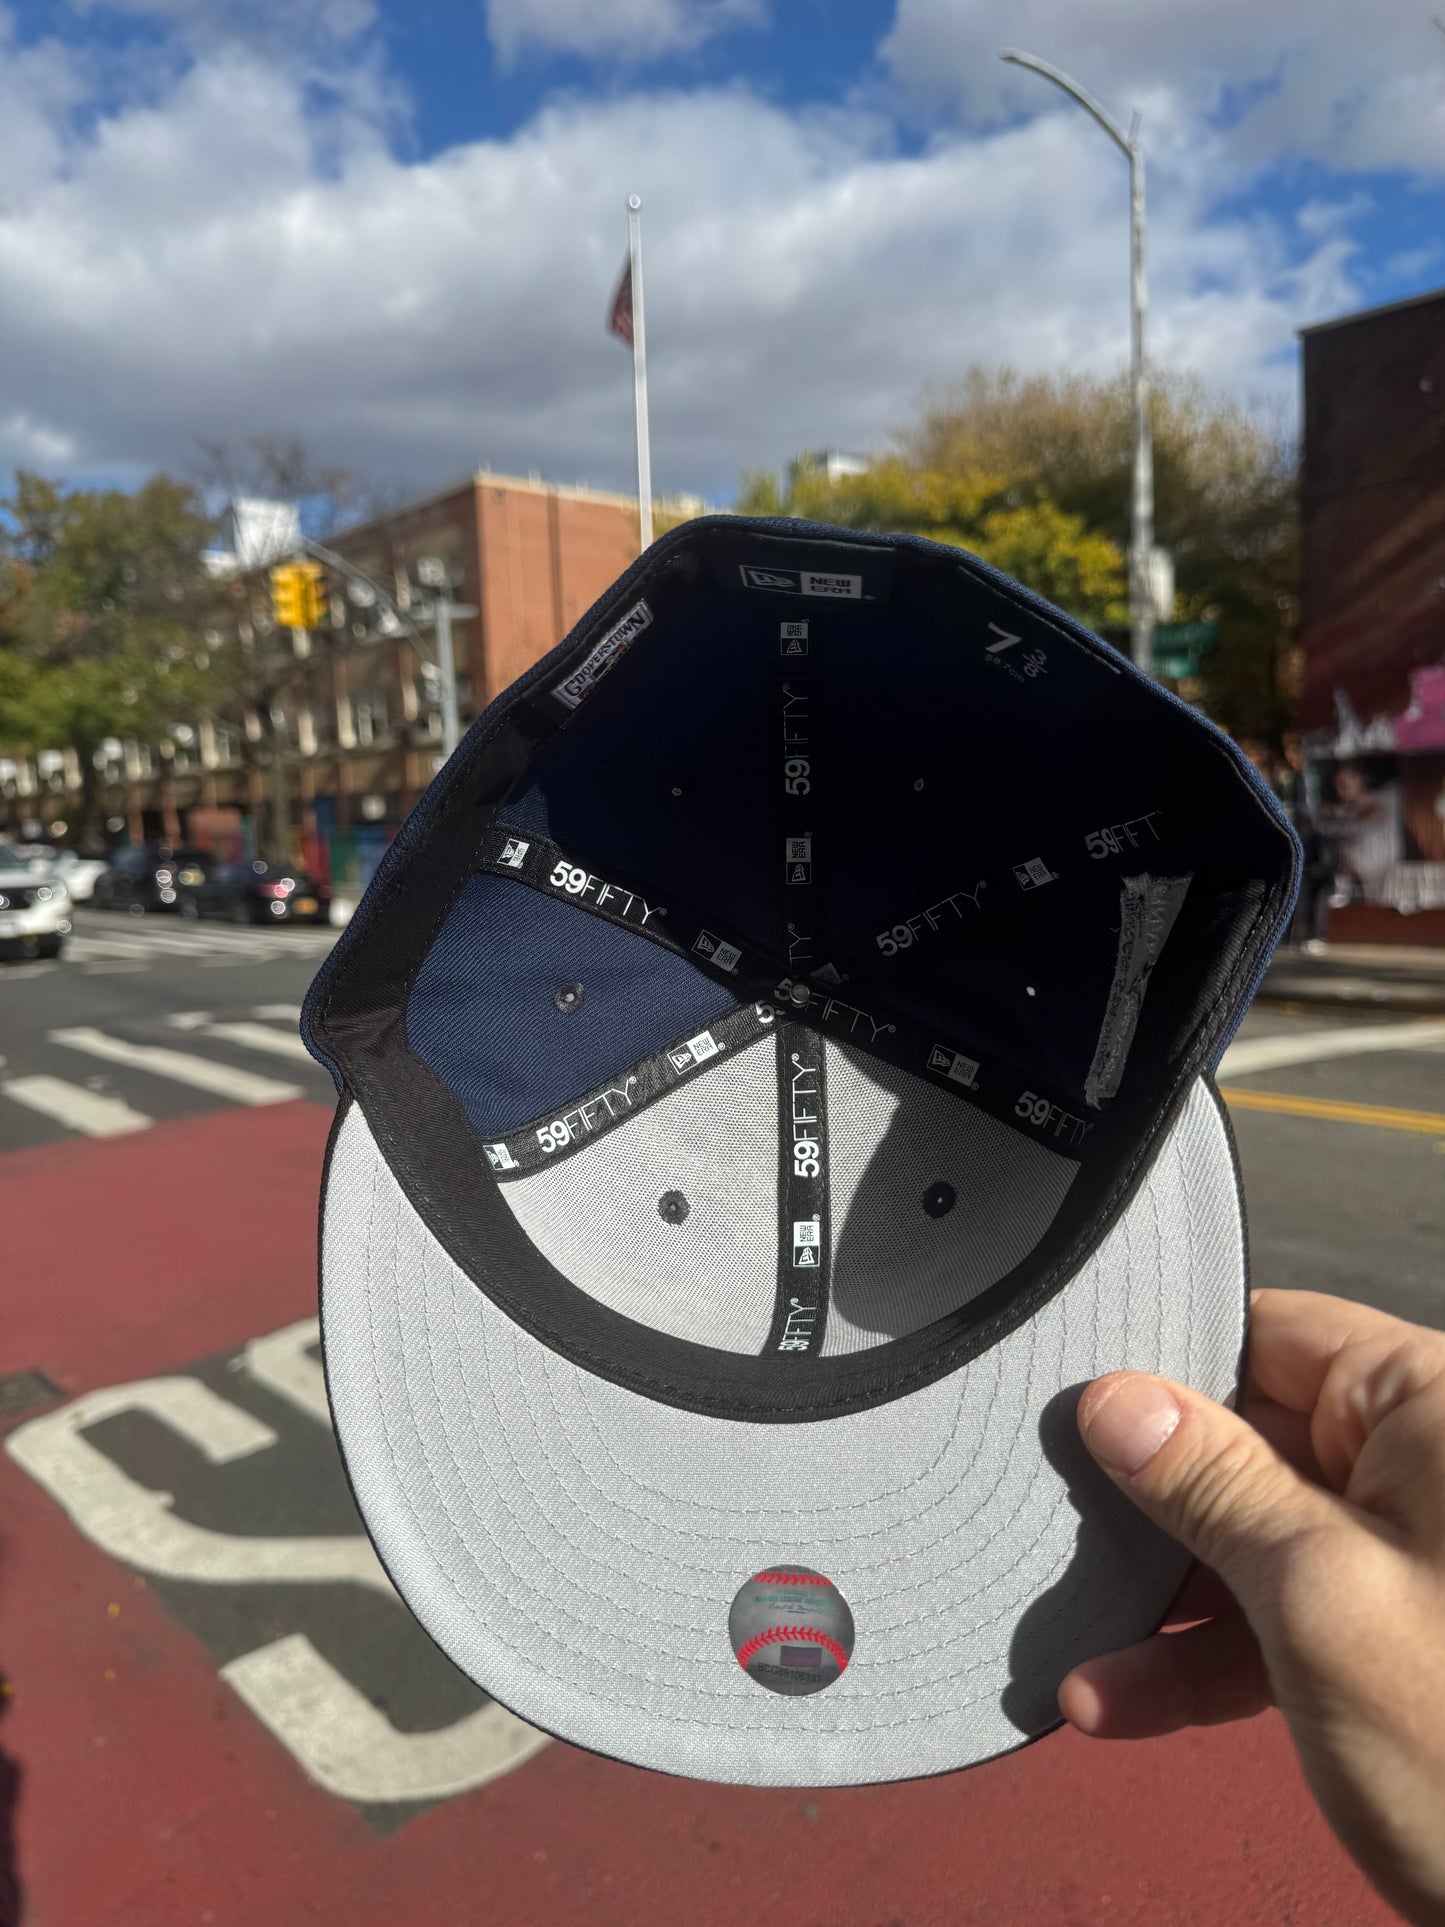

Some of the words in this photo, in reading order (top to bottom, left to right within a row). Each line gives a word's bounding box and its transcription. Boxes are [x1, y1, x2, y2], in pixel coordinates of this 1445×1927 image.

[810, 576, 851, 587] NEW
[564, 609, 646, 697] COOPERSTOWN
[985, 621, 1022, 653] 7
[1084, 812, 1160, 860] 59FIFT
[550, 860, 662, 925] 59FIFTY
[876, 882, 981, 956] 59FIFTY
[536, 1078, 632, 1153] 59FIFTY
[791, 1060, 820, 1178] 59FIFTY
